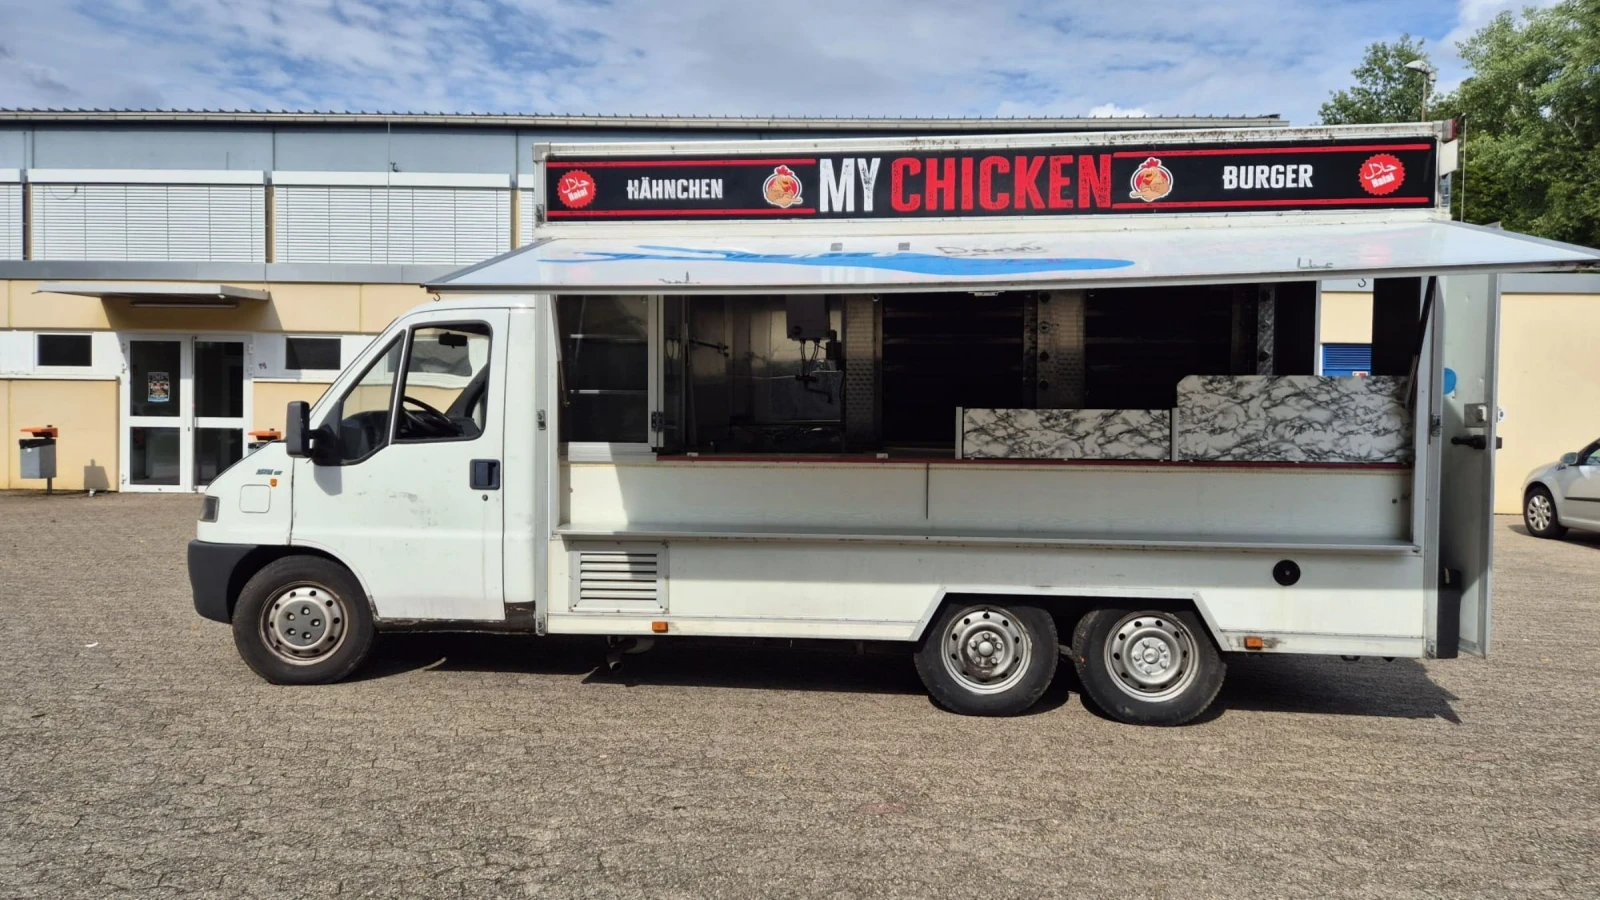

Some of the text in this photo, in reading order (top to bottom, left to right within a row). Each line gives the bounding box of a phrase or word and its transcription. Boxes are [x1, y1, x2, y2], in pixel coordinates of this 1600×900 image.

[1222, 164, 1313, 189] BURGER
[1364, 161, 1398, 180] حلال
[561, 177, 590, 194] حلال
[626, 176, 723, 199] HÄHNCHEN
[819, 154, 1112, 212] MY CHICKEN
